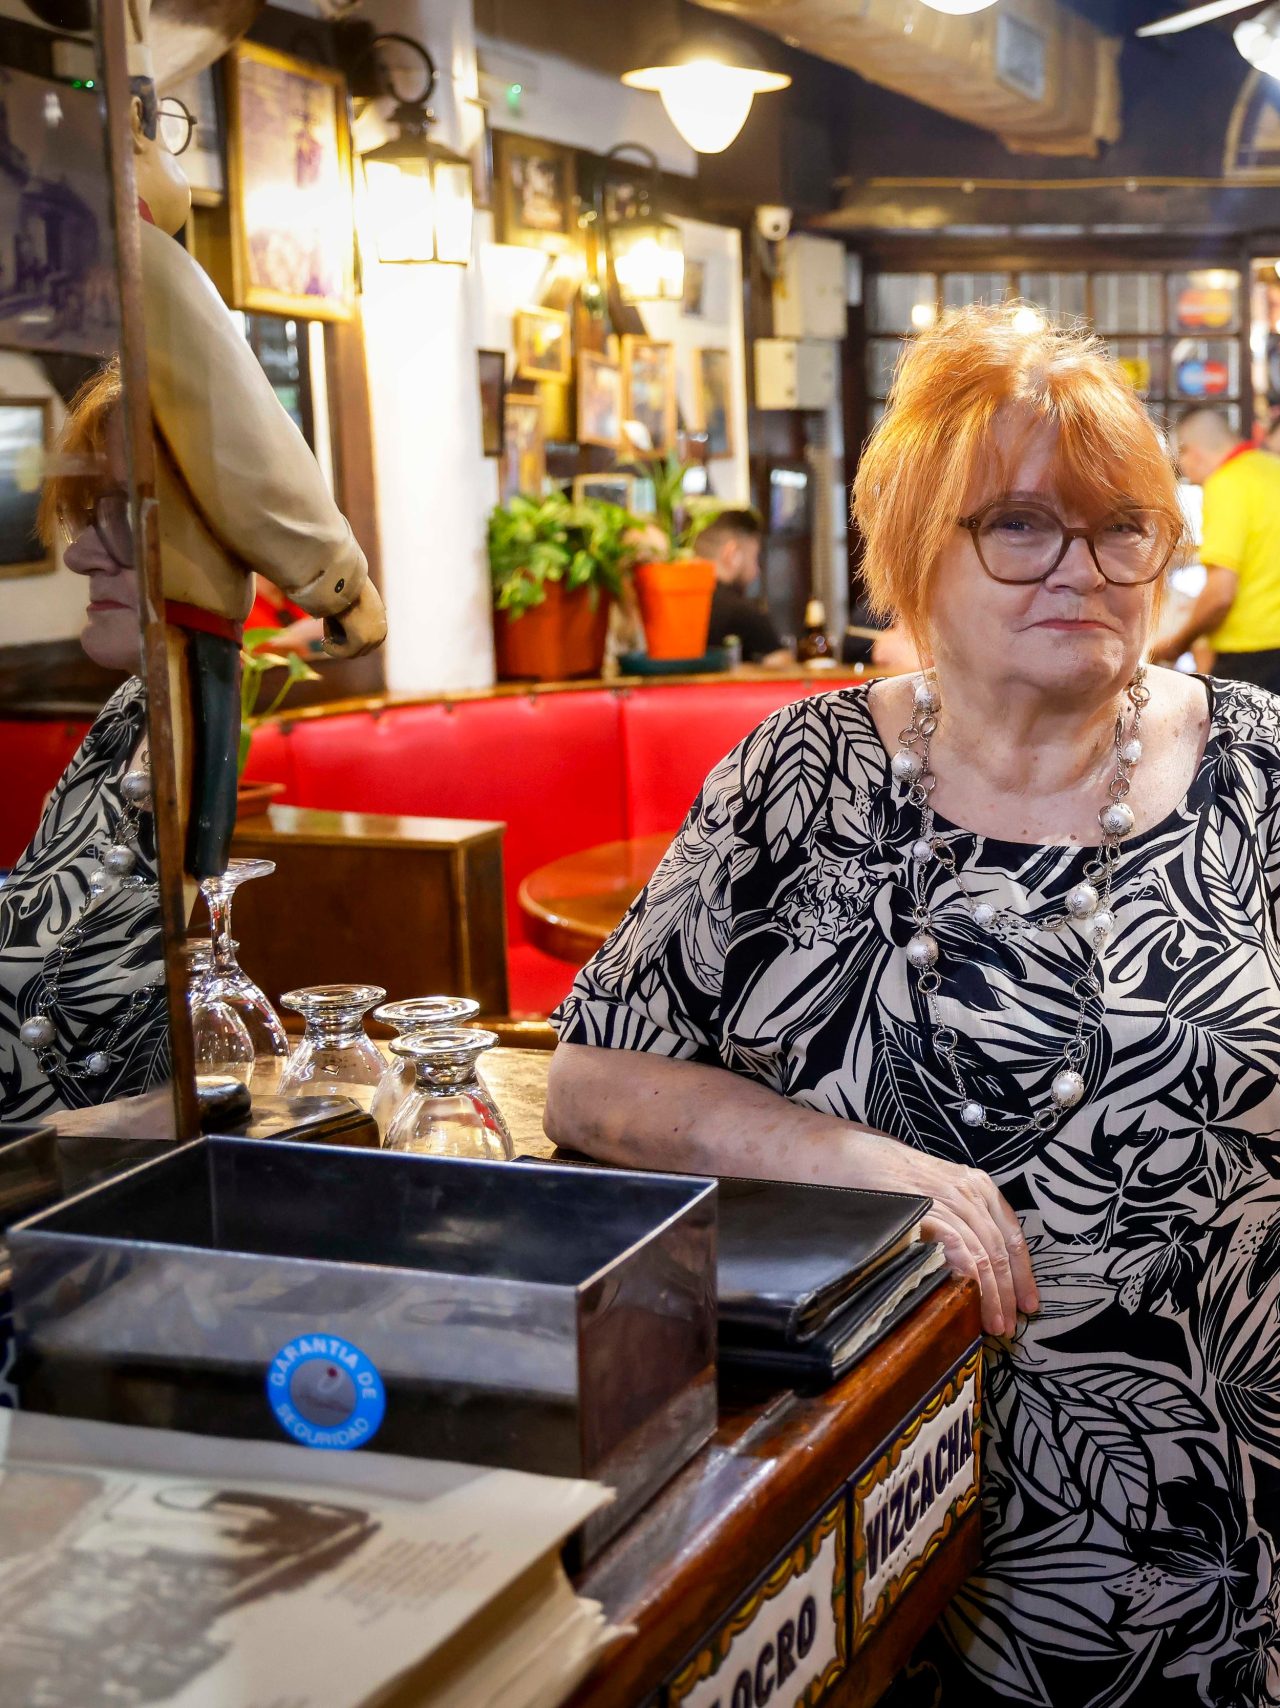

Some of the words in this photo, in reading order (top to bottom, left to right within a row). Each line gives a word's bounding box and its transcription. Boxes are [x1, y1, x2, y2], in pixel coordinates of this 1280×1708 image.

[269, 1336, 359, 1387] GARANTIA
[356, 1371, 377, 1400] DE
[865, 1407, 973, 1581] VIZCACHA
[708, 1594, 817, 1708] OCRO
